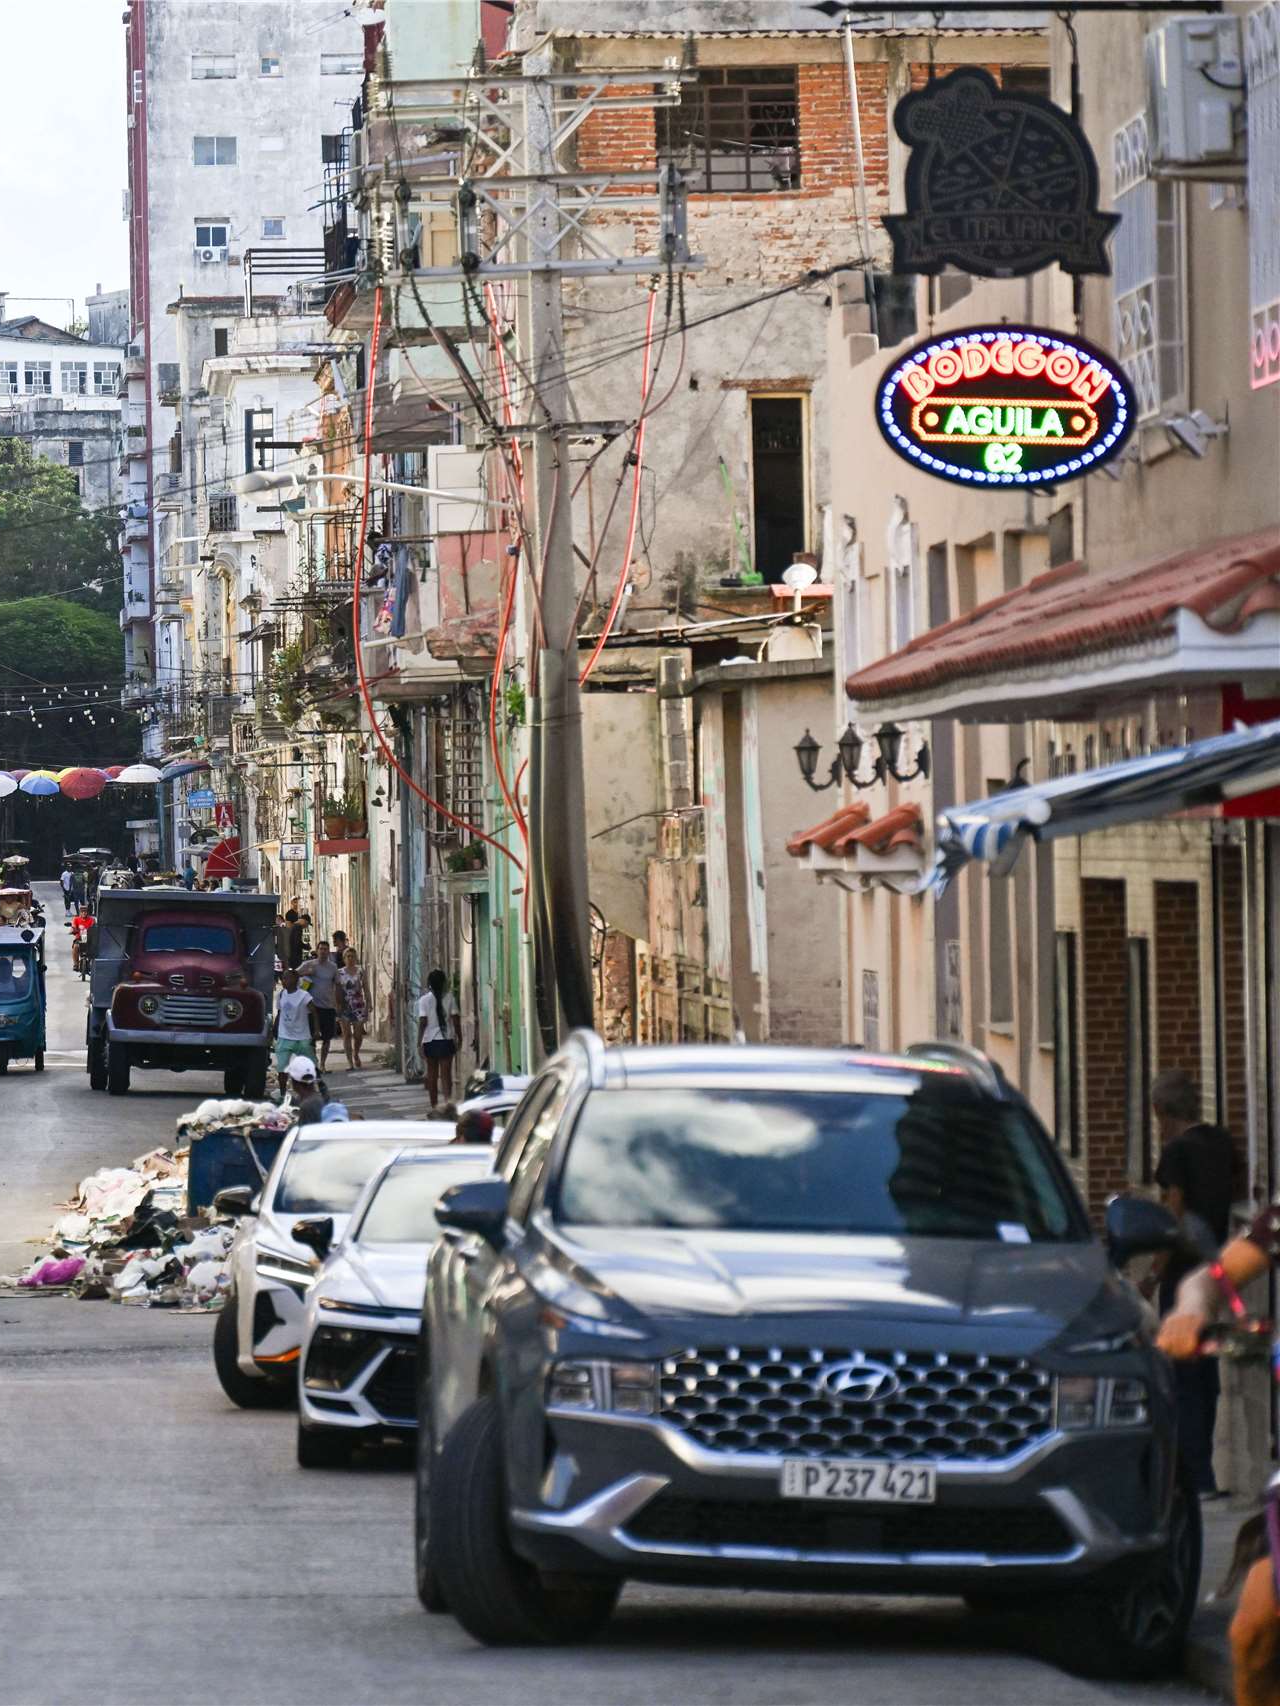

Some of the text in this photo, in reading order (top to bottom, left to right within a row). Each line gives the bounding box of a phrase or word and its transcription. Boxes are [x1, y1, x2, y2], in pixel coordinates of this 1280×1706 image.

[929, 215, 1077, 241] EL ITALIANO
[900, 338, 1112, 404] BODEGON
[944, 404, 1065, 438] AGUILA
[983, 442, 1023, 474] 62
